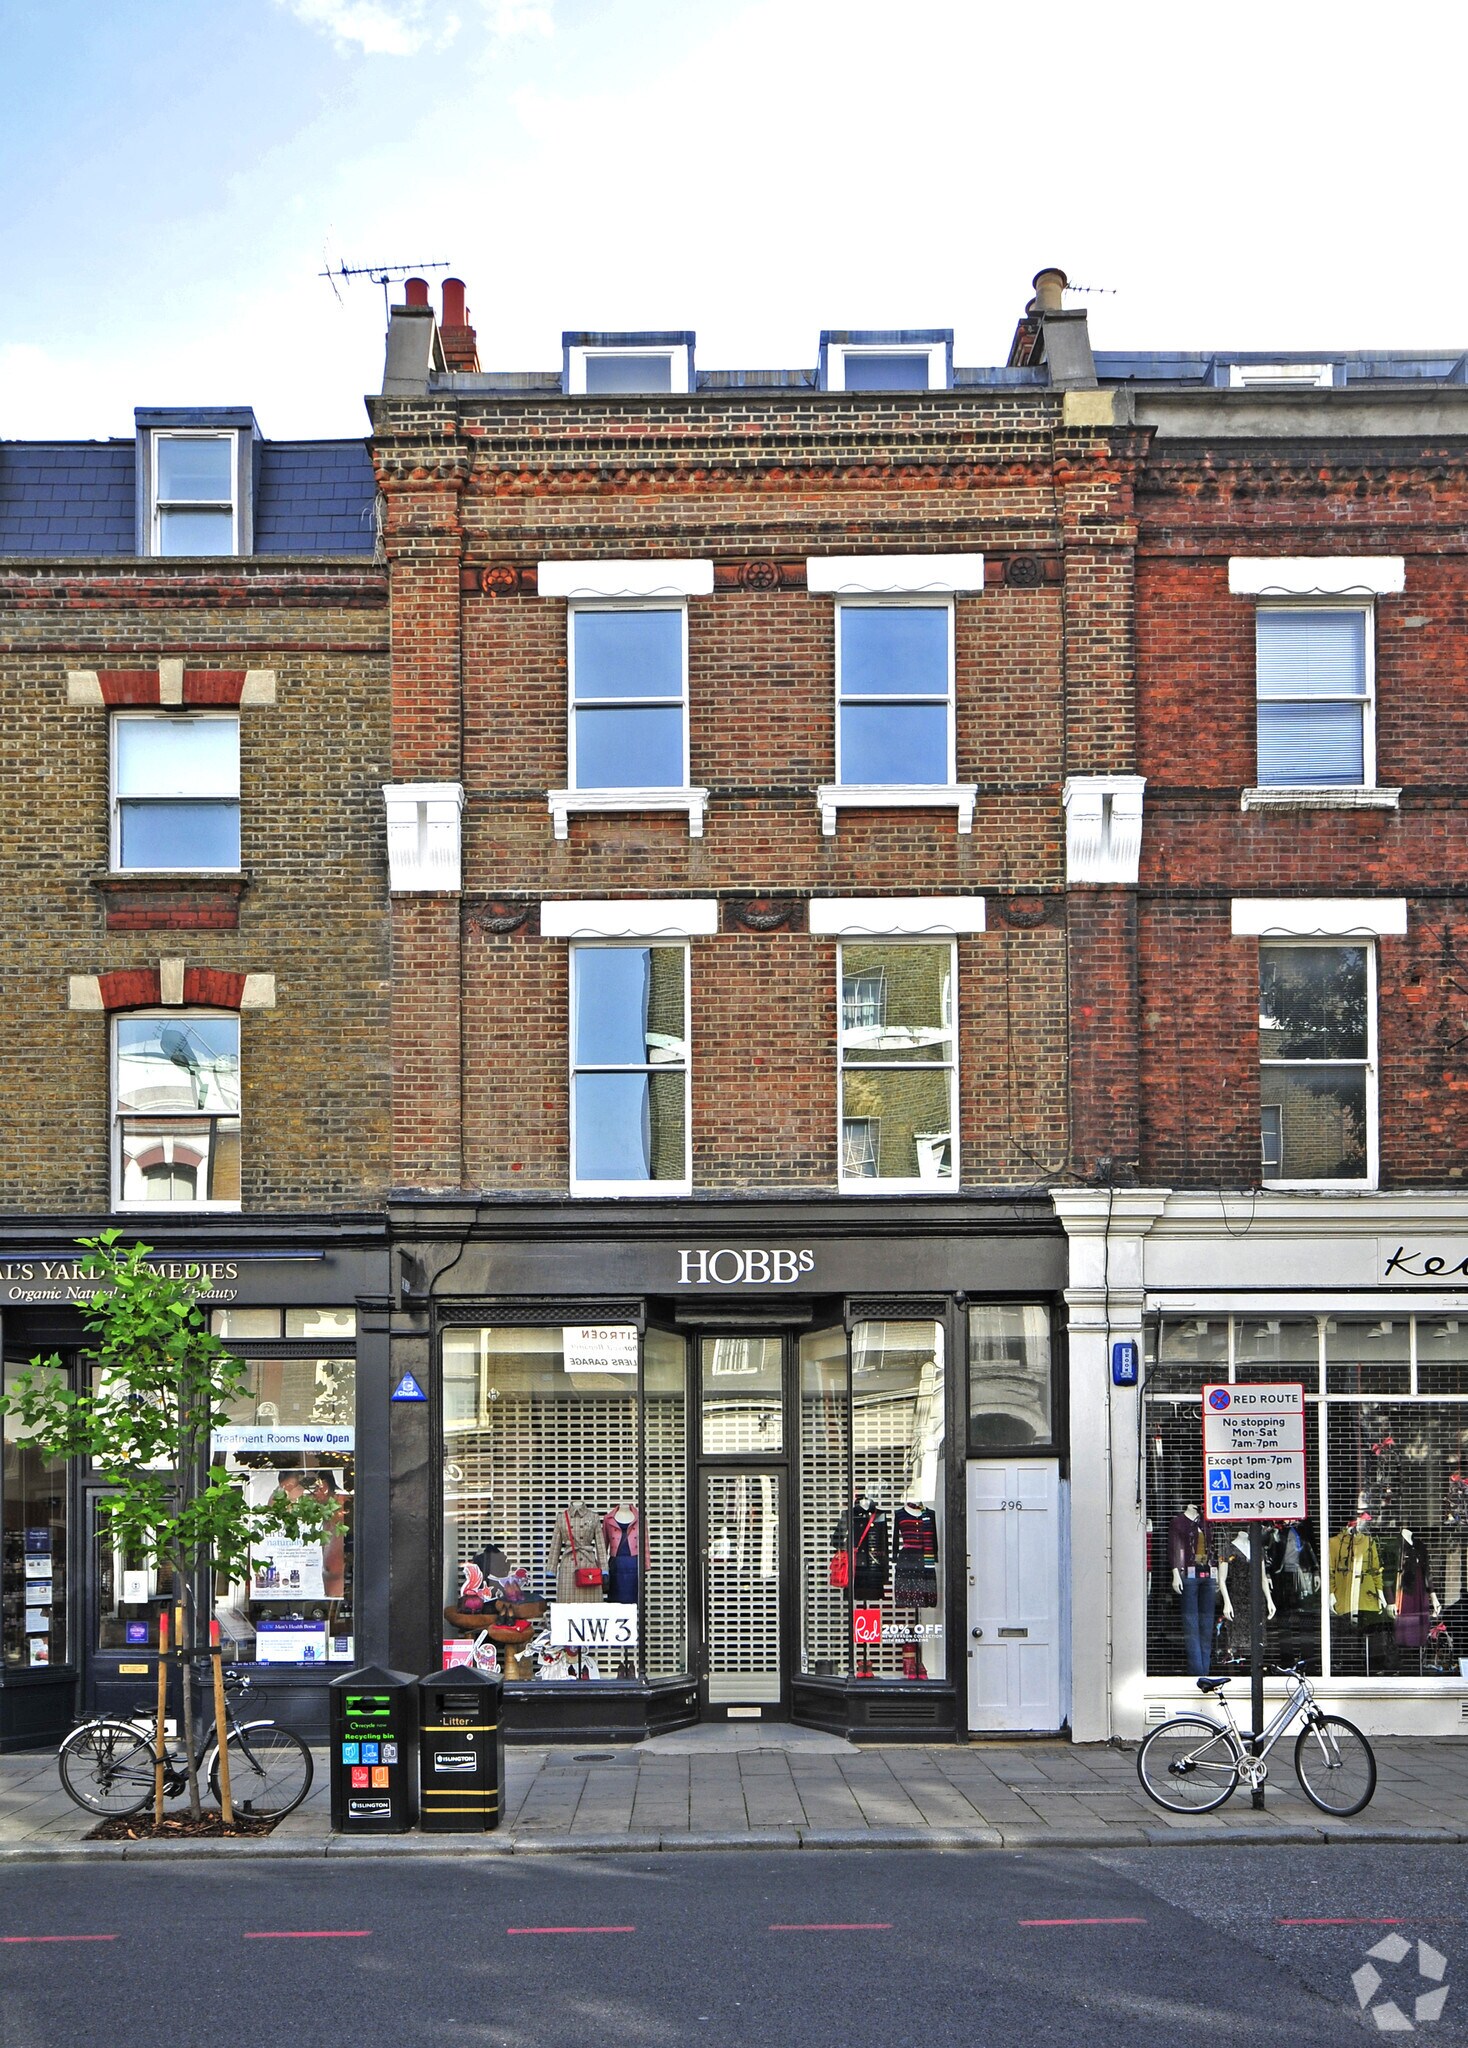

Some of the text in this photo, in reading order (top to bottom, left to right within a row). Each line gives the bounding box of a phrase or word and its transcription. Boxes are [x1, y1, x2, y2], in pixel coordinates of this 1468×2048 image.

[1385, 1246, 1468, 1276] Ke
[677, 1249, 815, 1284] HOBBS
[8, 1286, 62, 1302] Organic
[1234, 1394, 1298, 1404] RED ROUTE
[1223, 1417, 1285, 1427] No stopping
[1232, 1428, 1277, 1437] Mon-Sat
[215, 1433, 350, 1444] Treatment Rooms Now Open
[1231, 1439, 1278, 1448] 7am-7pm
[1208, 1455, 1292, 1466] Except 1pm-7pm
[1233, 1470, 1271, 1480] loading
[1258, 1481, 1273, 1490] 20
[1276, 1480, 1301, 1489] mins
[1001, 1500, 1023, 1511] 296
[1258, 1500, 1265, 1509] 3
[1269, 1500, 1298, 1508] hours
[614, 1618, 632, 1642] 3
[855, 1616, 880, 1643] Red
[881, 1624, 943, 1635] 20% OFF
[443, 1717, 470, 1726] Litter
[345, 1733, 381, 1741] Recycling
